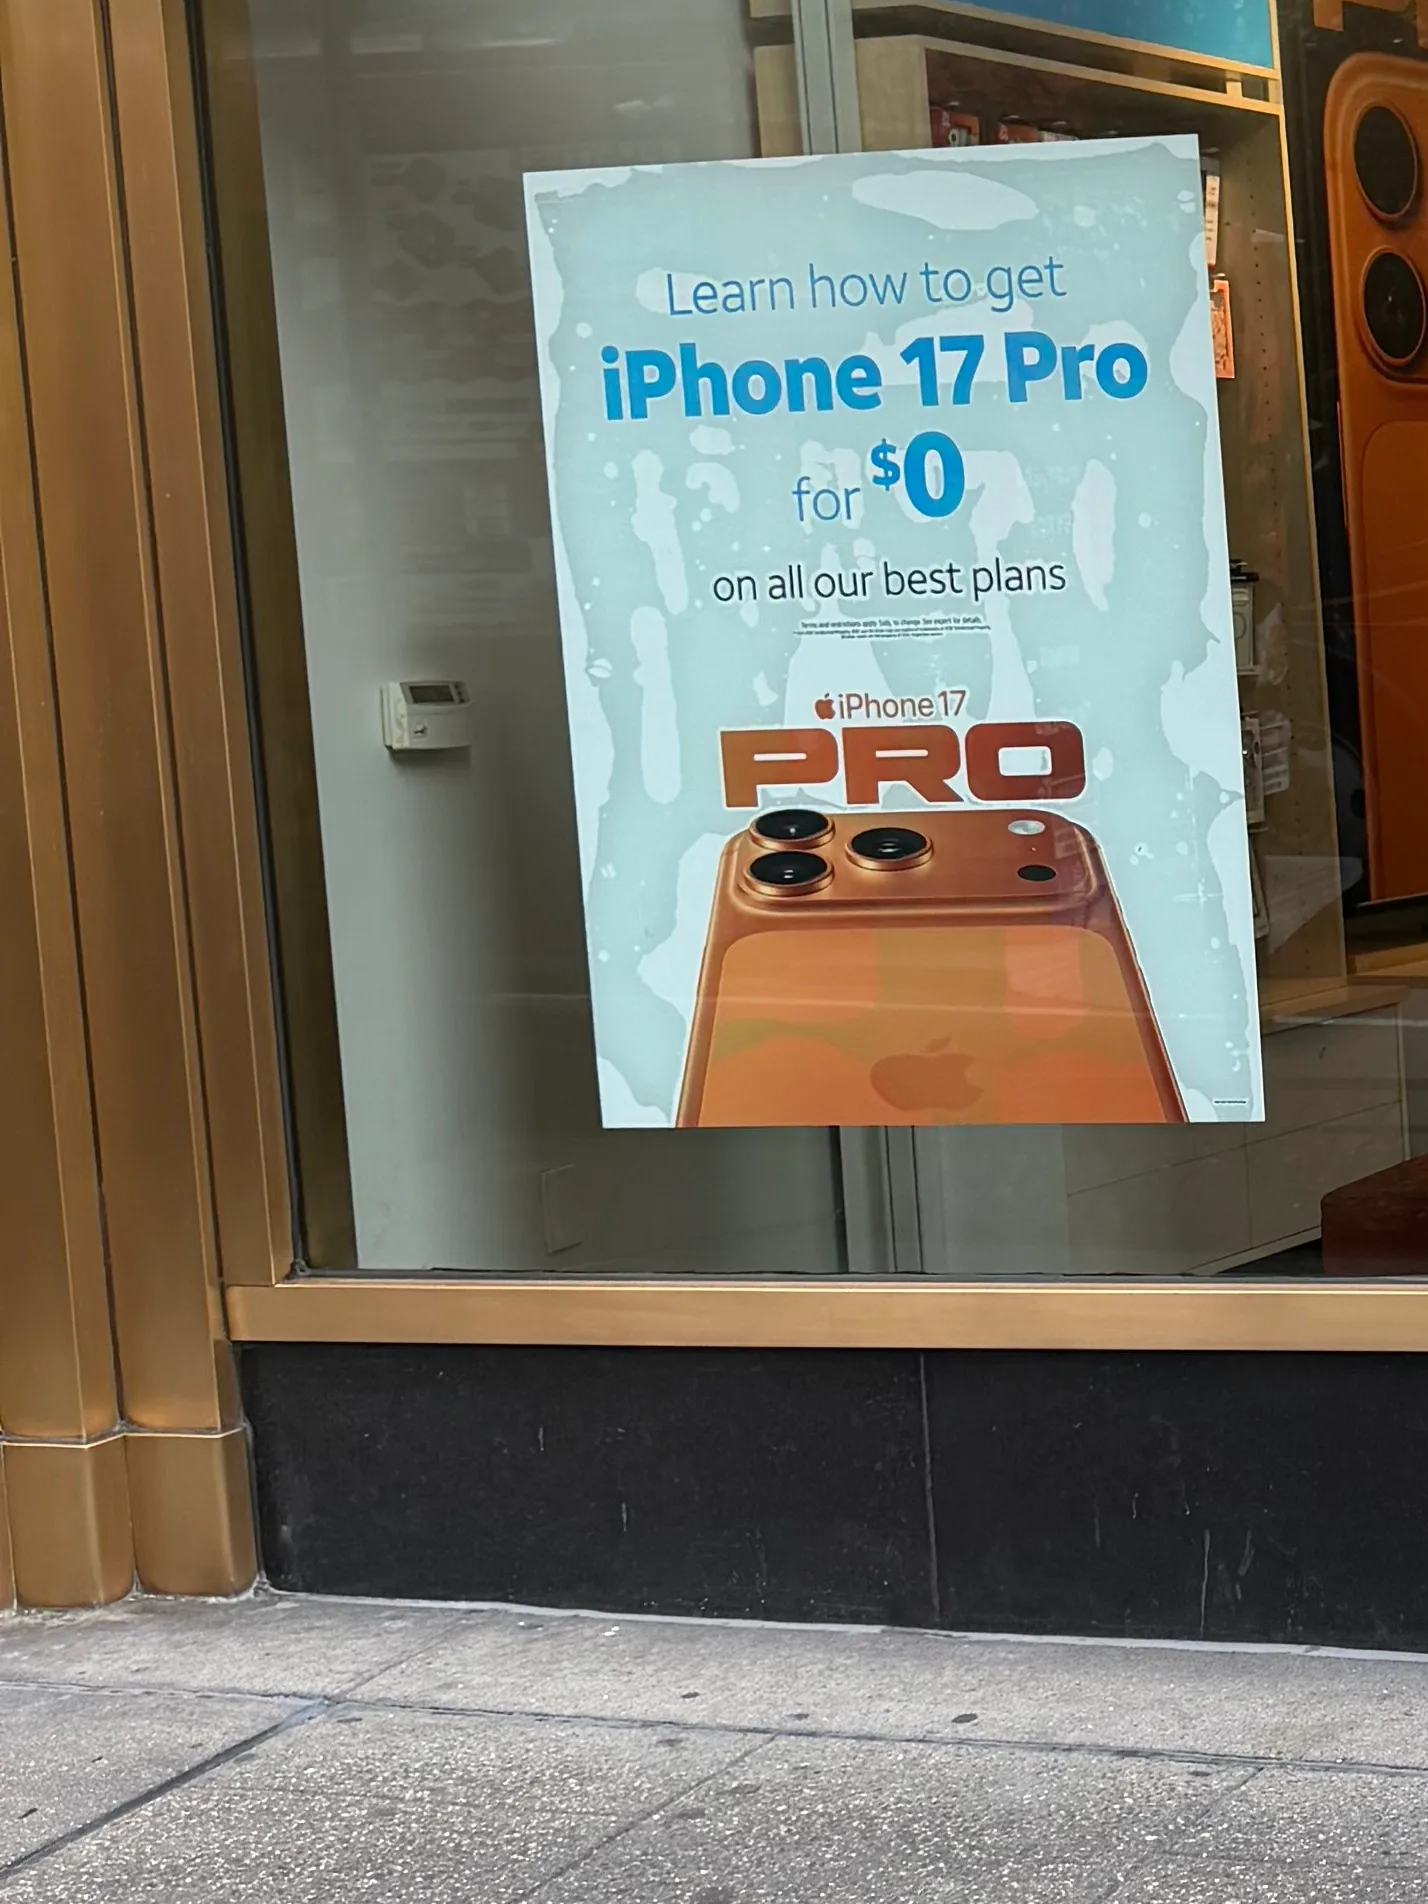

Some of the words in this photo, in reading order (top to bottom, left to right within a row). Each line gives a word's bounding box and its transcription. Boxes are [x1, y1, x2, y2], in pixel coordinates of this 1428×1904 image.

[667, 272, 796, 316] Learn
[808, 263, 908, 309] how
[924, 260, 973, 303] to
[985, 256, 1067, 313] get
[600, 342, 883, 421] iPhone
[900, 334, 985, 408] 17
[1003, 331, 1149, 404] Pro
[792, 476, 861, 523] for
[870, 431, 965, 519] $0
[712, 573, 758, 602] on
[767, 564, 803, 600] all
[814, 569, 874, 599] our
[883, 561, 964, 596] best
[971, 557, 1067, 601] plans
[839, 691, 934, 720] iPhone
[938, 689, 967, 717] 17
[719, 720, 1087, 808] PRO
